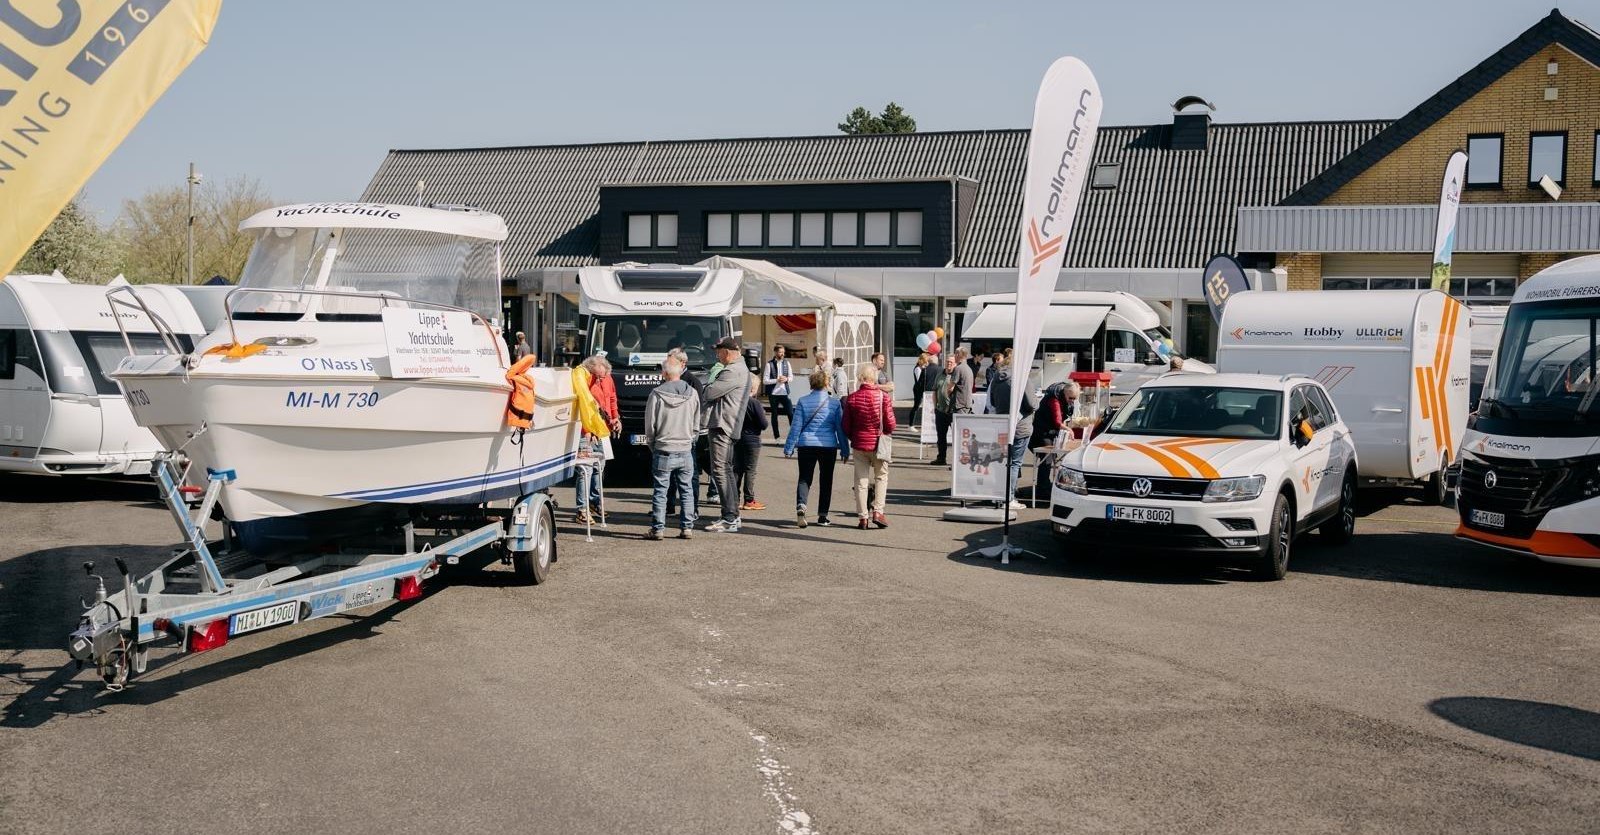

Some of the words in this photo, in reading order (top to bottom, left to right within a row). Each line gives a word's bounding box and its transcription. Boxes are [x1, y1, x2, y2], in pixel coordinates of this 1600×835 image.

[85, 3, 149, 67] 196
[276, 206, 400, 219] Yachtschule
[418, 313, 440, 326] Lippe
[408, 332, 454, 345] Yachtschule
[1303, 327, 1345, 339] Hobby
[285, 391, 341, 408] MI-M
[347, 391, 379, 408] 730
[1113, 505, 1125, 518] HF
[1132, 508, 1144, 519] FK
[1146, 509, 1171, 522] 8002
[236, 616, 250, 632] MI
[256, 610, 270, 628] LY
[270, 604, 295, 624] 1900
